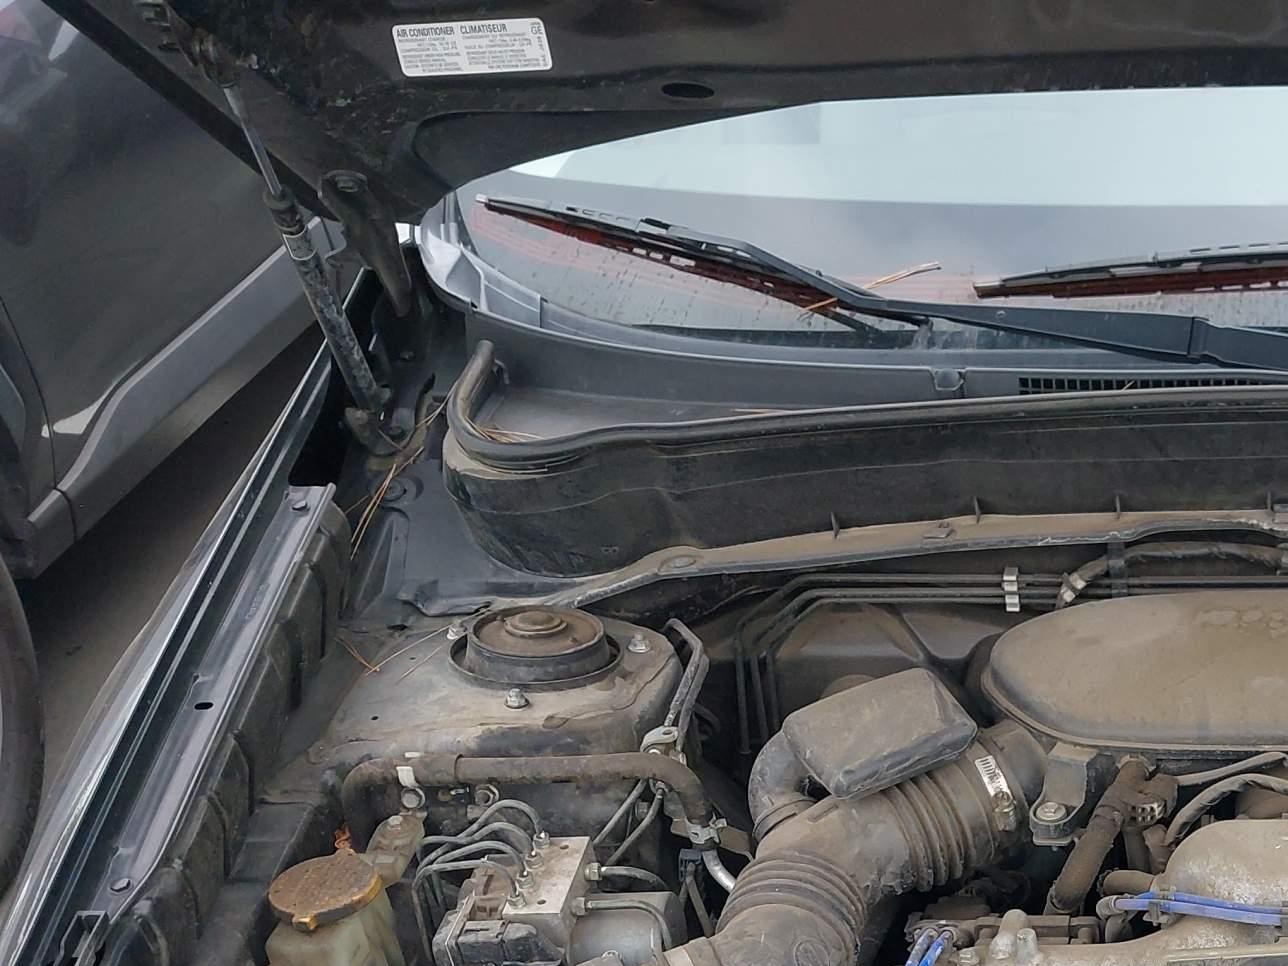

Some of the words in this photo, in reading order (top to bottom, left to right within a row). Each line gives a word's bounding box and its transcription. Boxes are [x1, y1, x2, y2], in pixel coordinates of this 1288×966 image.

[396, 28, 408, 38] AIR
[408, 26, 455, 37] CONDITIONER
[460, 23, 508, 34] CLIMATISEUR
